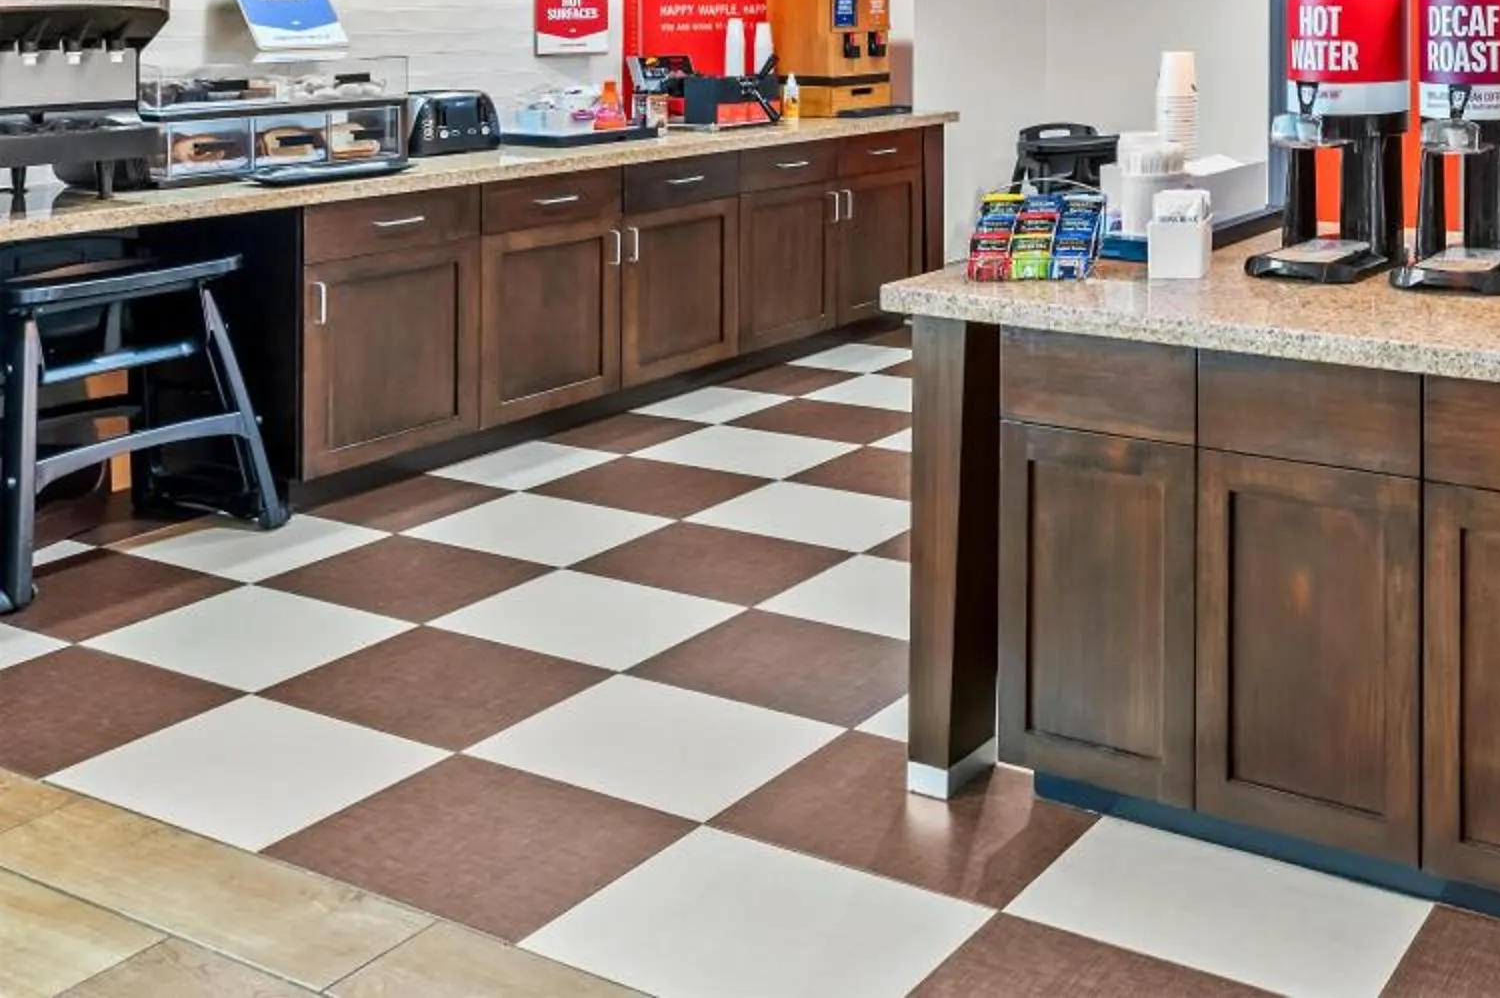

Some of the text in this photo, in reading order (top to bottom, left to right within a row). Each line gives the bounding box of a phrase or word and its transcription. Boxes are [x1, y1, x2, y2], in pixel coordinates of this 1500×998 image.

[546, 7, 600, 21] SURFACES
[660, 4, 695, 16] HAPPY
[1299, 5, 1343, 37] HOT
[1427, 5, 1500, 37] DECAF
[1291, 38, 1360, 71] WATER
